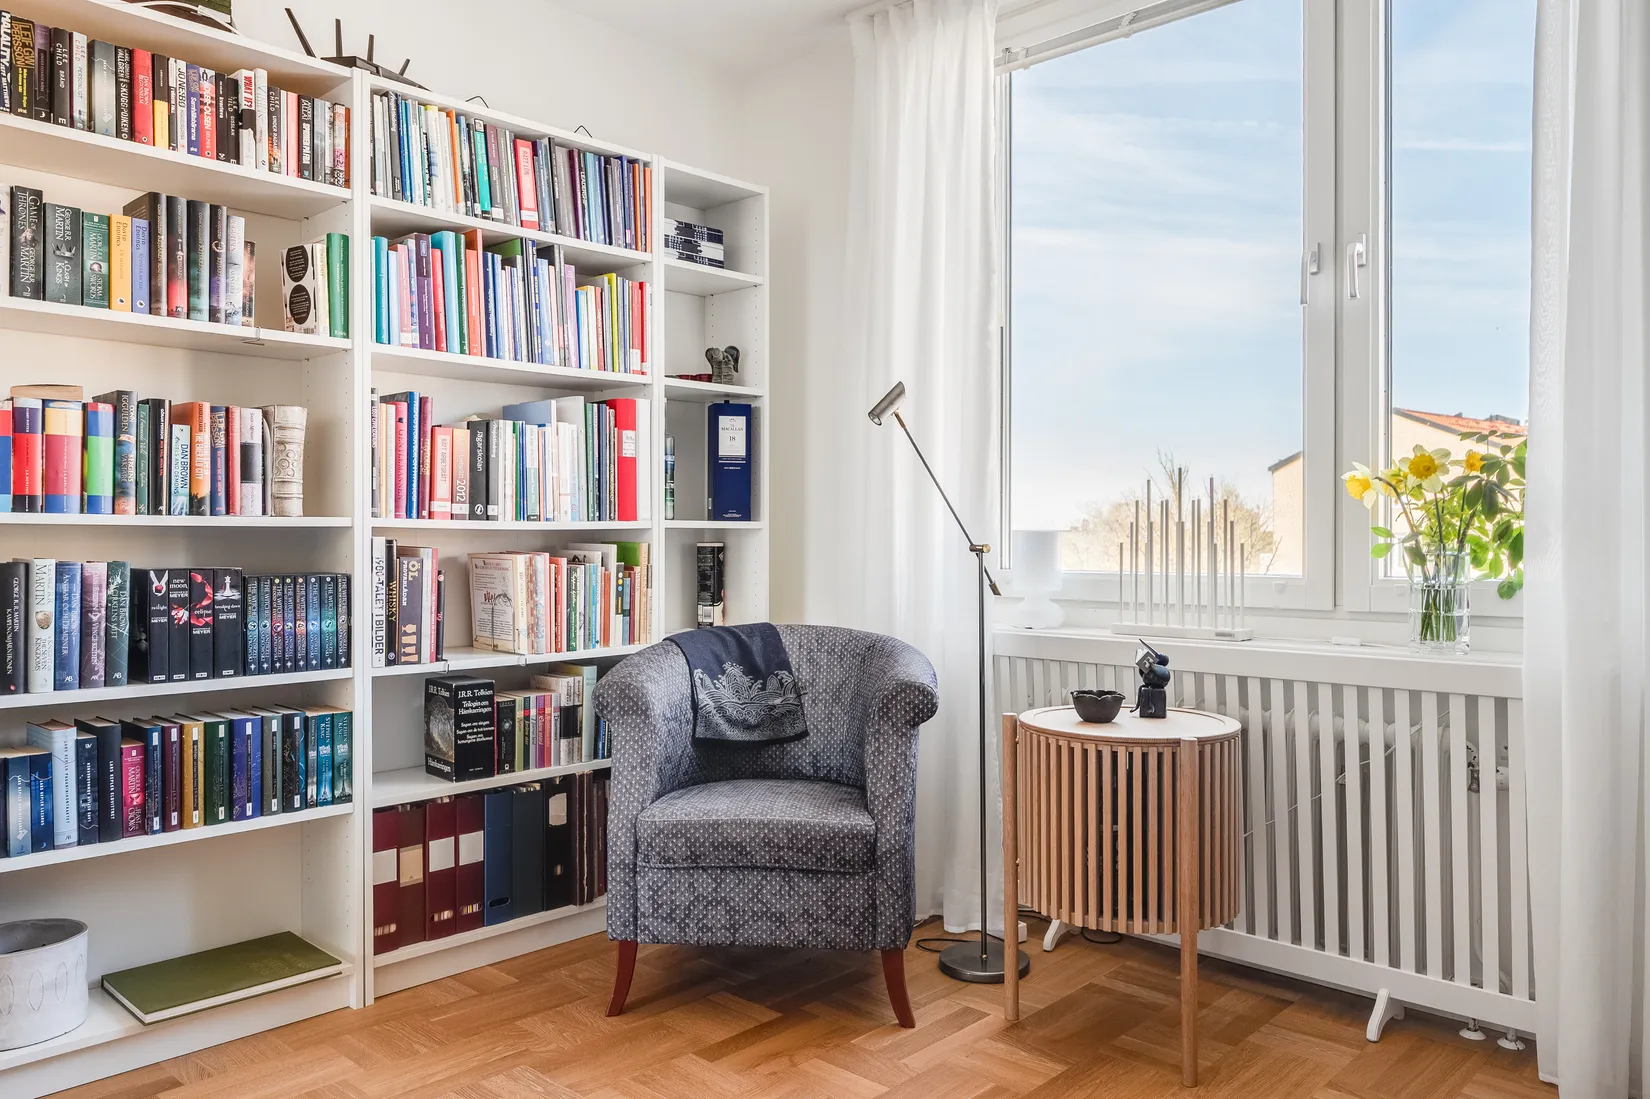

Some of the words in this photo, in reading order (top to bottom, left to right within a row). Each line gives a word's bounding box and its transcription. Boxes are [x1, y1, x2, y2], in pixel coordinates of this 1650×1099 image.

[12, 23, 25, 66] PERSSON
[19, 25, 33, 46] LEIF
[24, 48, 35, 66] GW
[178, 68, 185, 79] JO
[243, 76, 252, 95] WHAT
[120, 83, 129, 132] SKUGGPOJKEN
[244, 97, 252, 108] IF?
[18, 192, 28, 230] THRONES
[29, 196, 40, 222] GAME
[64, 208, 72, 230] GEORGE
[55, 207, 65, 241] MARTIN
[20, 246, 29, 283] MARTIN
[56, 262, 64, 284] KINGS
[121, 395, 129, 432] IGGULDEN
[217, 413, 225, 431] LEIF
[195, 433, 203, 442] THE
[211, 414, 221, 447] PERSSON
[181, 444, 189, 460] DAN
[195, 444, 203, 467] EMERALD
[475, 430, 483, 471] Jägarskolan
[181, 462, 189, 489] BROWN
[195, 468, 203, 480] CITY
[456, 479, 466, 502] 2012
[408, 561, 420, 581] ÖL
[35, 564, 47, 606] MARTIN
[62, 574, 70, 601] ÄNGLAR
[375, 620, 384, 655] BILDER
[462, 700, 480, 708] Trilogin
[474, 689, 493, 697] Tolkien
